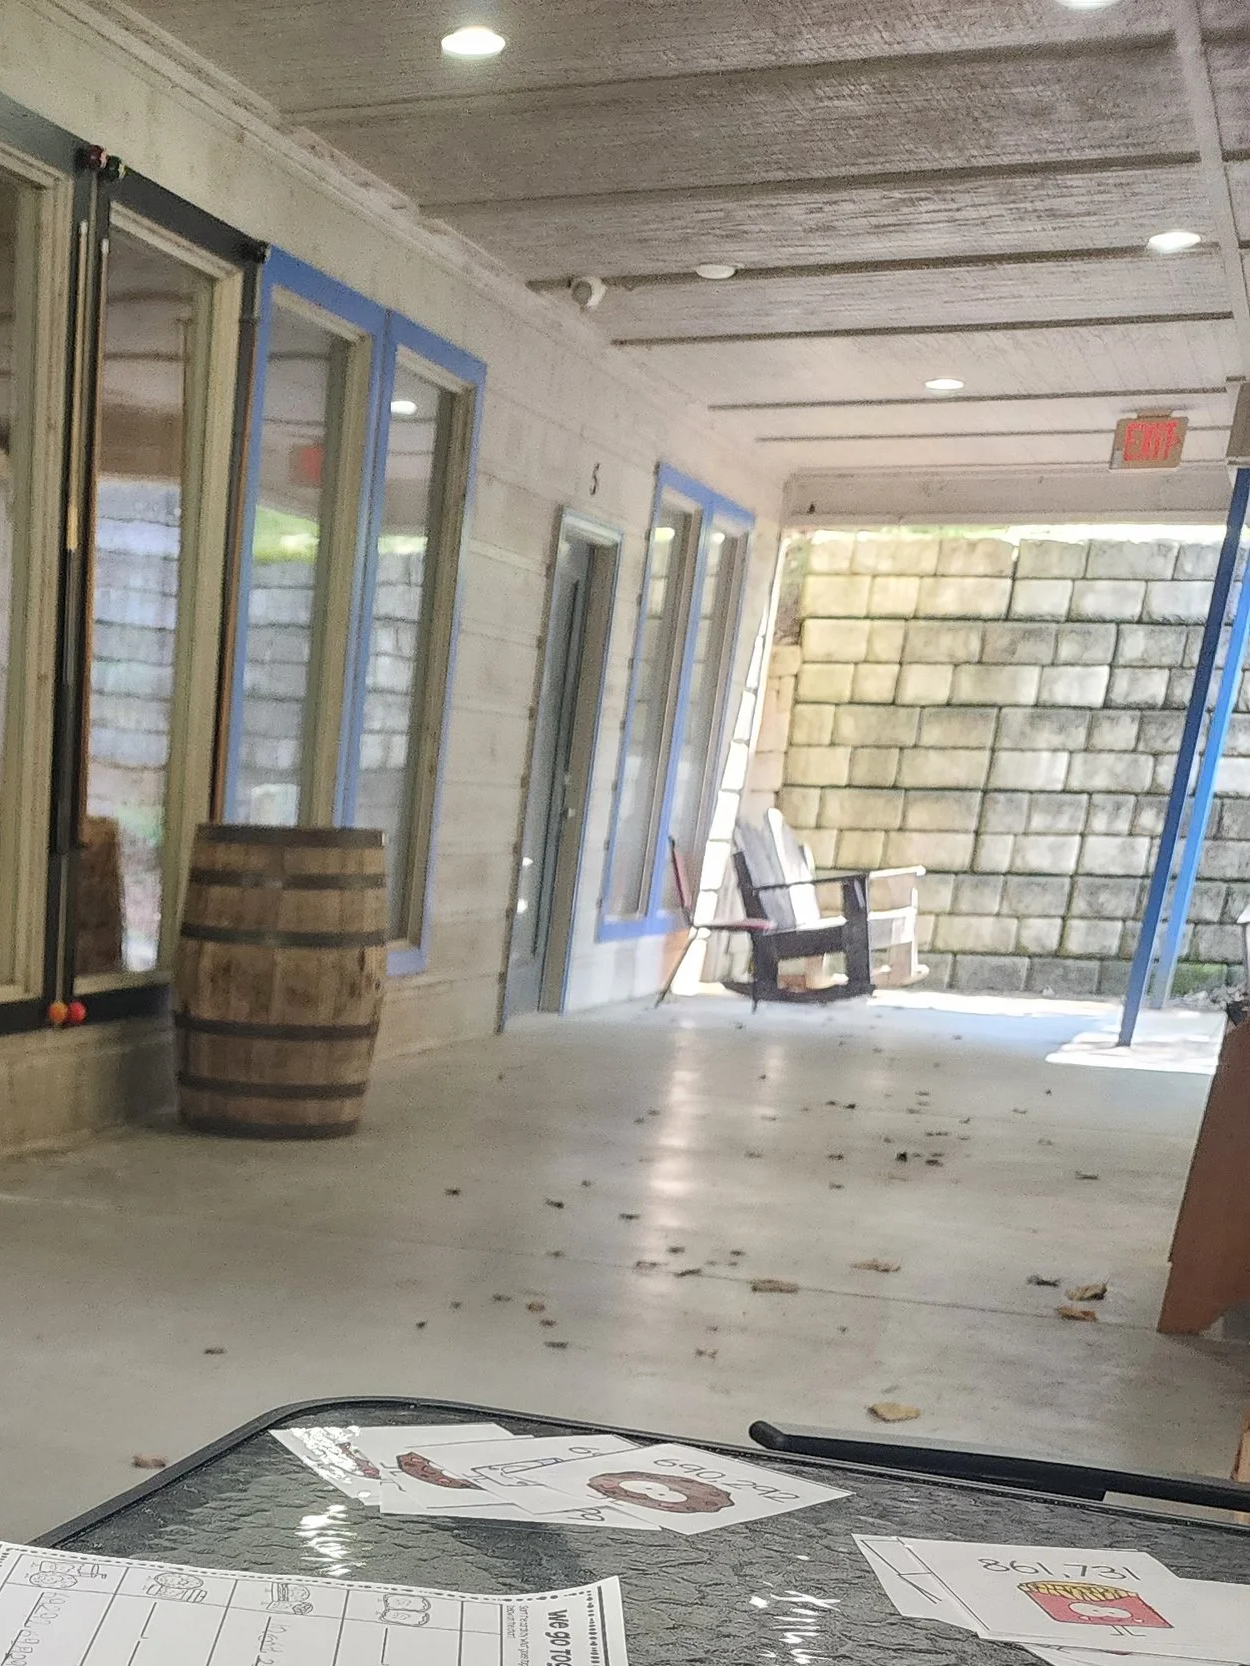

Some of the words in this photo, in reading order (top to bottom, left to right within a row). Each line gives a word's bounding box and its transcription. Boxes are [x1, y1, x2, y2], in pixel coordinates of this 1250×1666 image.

[1123, 420, 1178, 461] EXIT
[653, 1458, 801, 1504] 690,292
[977, 1558, 1141, 1581] 861,731
